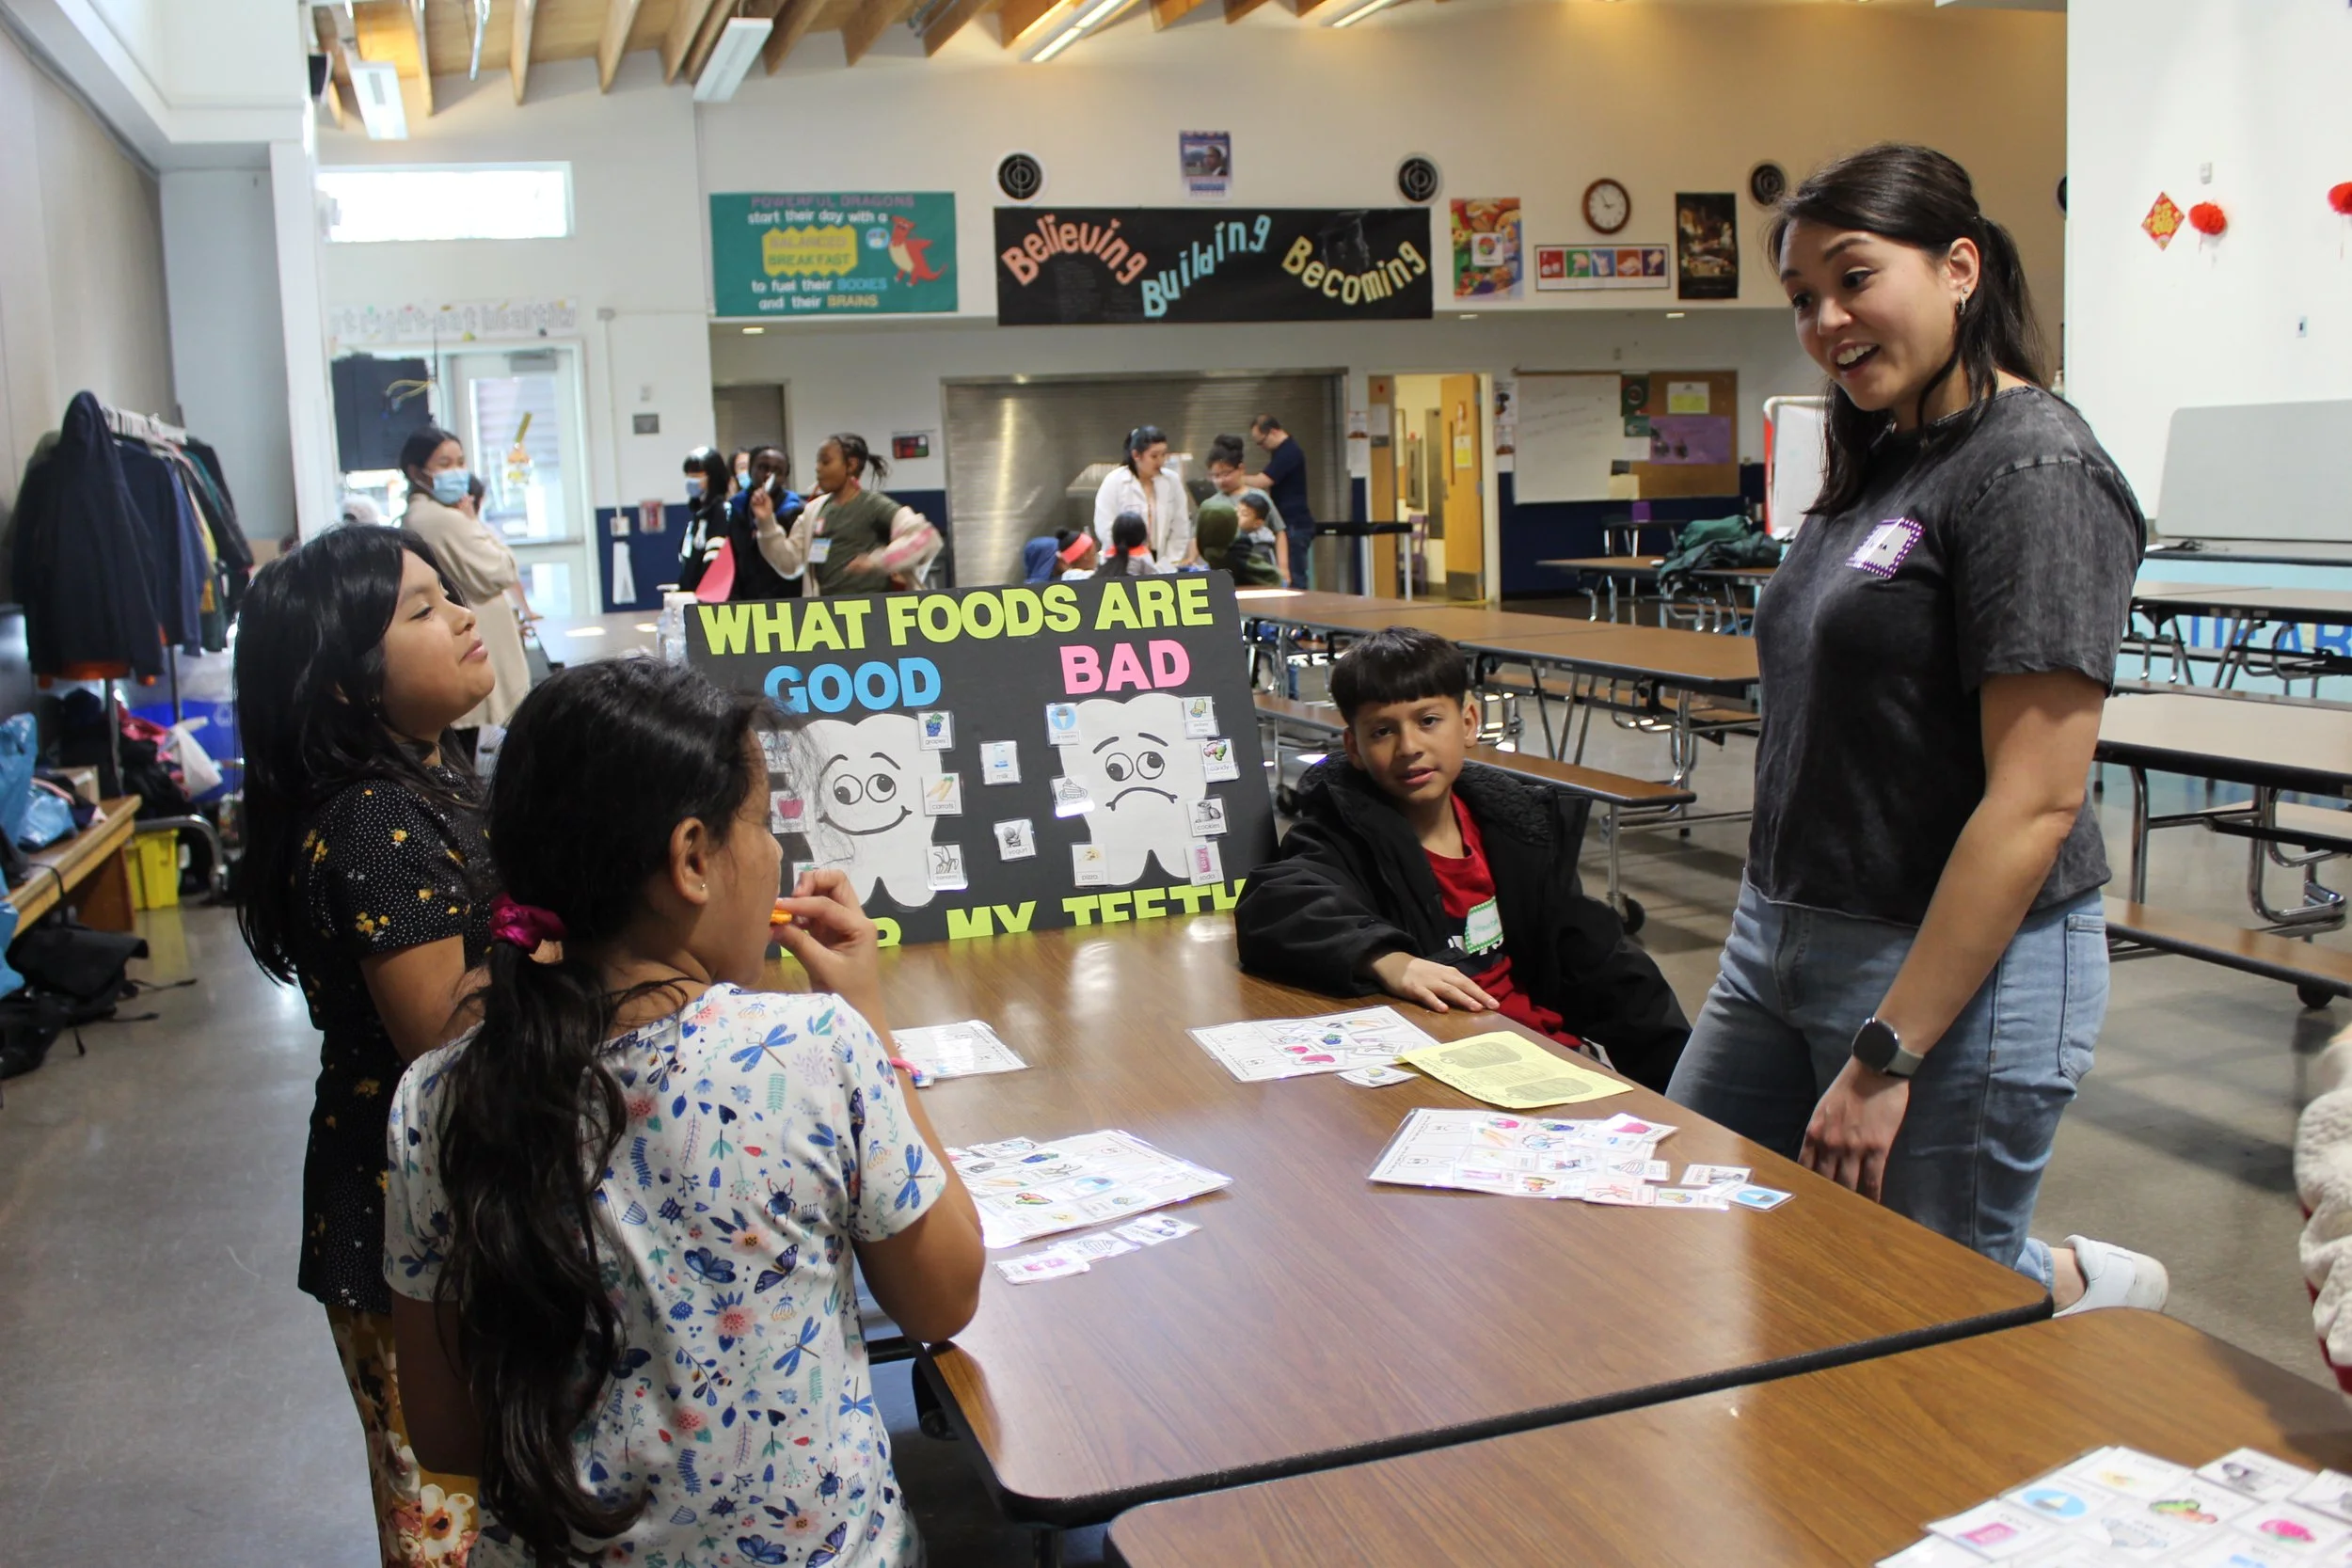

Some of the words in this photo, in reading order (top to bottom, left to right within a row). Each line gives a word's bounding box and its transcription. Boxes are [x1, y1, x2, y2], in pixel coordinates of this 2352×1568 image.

[748, 211, 780, 224] start
[785, 210, 815, 222] their
[818, 210, 844, 224] day
[848, 210, 875, 223] with
[878, 213, 888, 222] a
[752, 195, 836, 207] POWERFUL
[840, 194, 915, 206] DRAGONS
[767, 252, 851, 267] BREAKFAST
[770, 235, 847, 249] BALANCED
[1000, 213, 1149, 287] Believing
[1140, 214, 1272, 318] Building
[1280, 235, 1427, 306] Becoming
[752, 279, 767, 293] to
[771, 279, 797, 293] fuel
[802, 278, 833, 292] their
[836, 277, 888, 291] BODIES
[758, 297, 785, 310] and
[791, 295, 821, 309] their
[827, 294, 879, 308] BRAINS
[697, 599, 871, 656] WHAT
[885, 583, 1082, 647] FOODS
[1094, 578, 1215, 630] ARE
[1059, 639, 1191, 695] BAD
[763, 656, 942, 715] GOOD
